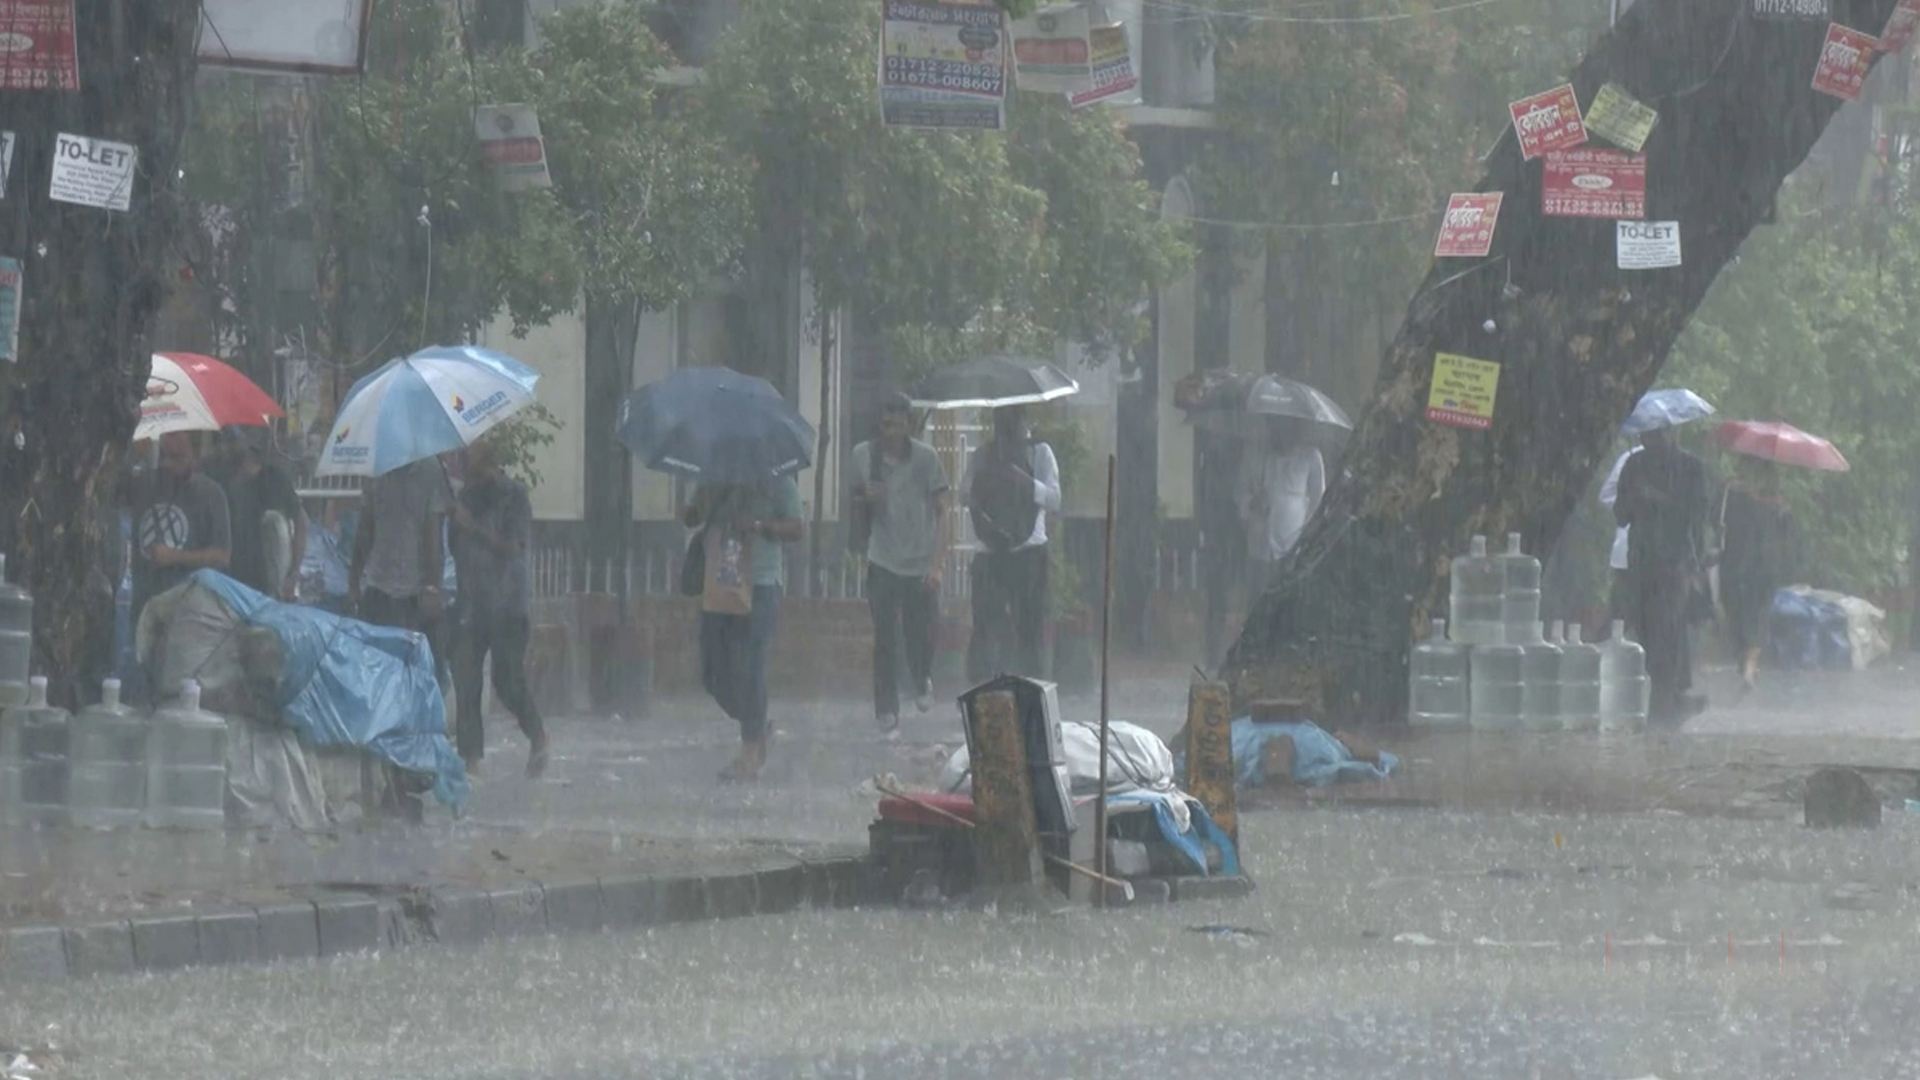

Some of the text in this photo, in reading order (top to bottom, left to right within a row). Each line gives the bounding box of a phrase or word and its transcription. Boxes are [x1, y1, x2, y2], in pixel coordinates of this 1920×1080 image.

[59, 139, 129, 168] TO-LET
[1619, 225, 1672, 240] TO-LET
[461, 390, 508, 423] BERGER
